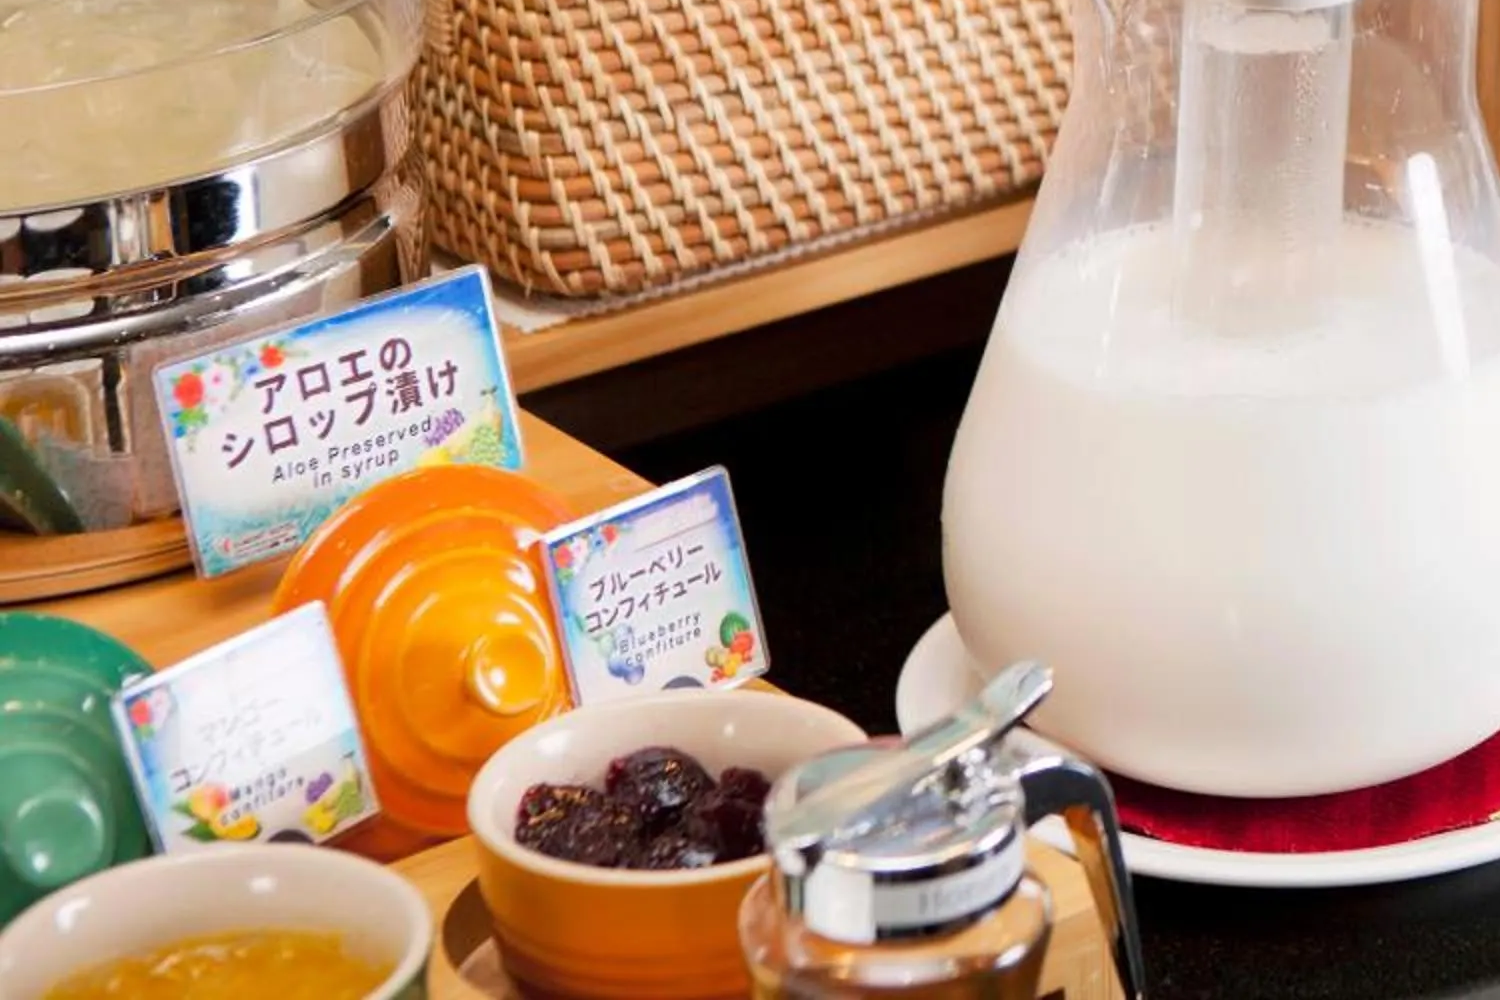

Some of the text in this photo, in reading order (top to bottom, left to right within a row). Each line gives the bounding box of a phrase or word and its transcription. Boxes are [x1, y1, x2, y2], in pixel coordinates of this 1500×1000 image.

[254, 337, 412, 414] アロエの
[222, 360, 458, 469] シロップ漬け
[272, 414, 432, 484] Aloe Preserved
[313, 449, 400, 488] in syrup
[585, 561, 722, 634] コンフィチュール
[589, 544, 704, 602] ブルーベリー
[619, 612, 701, 655] Blueberry
[625, 626, 701, 667] confiture
